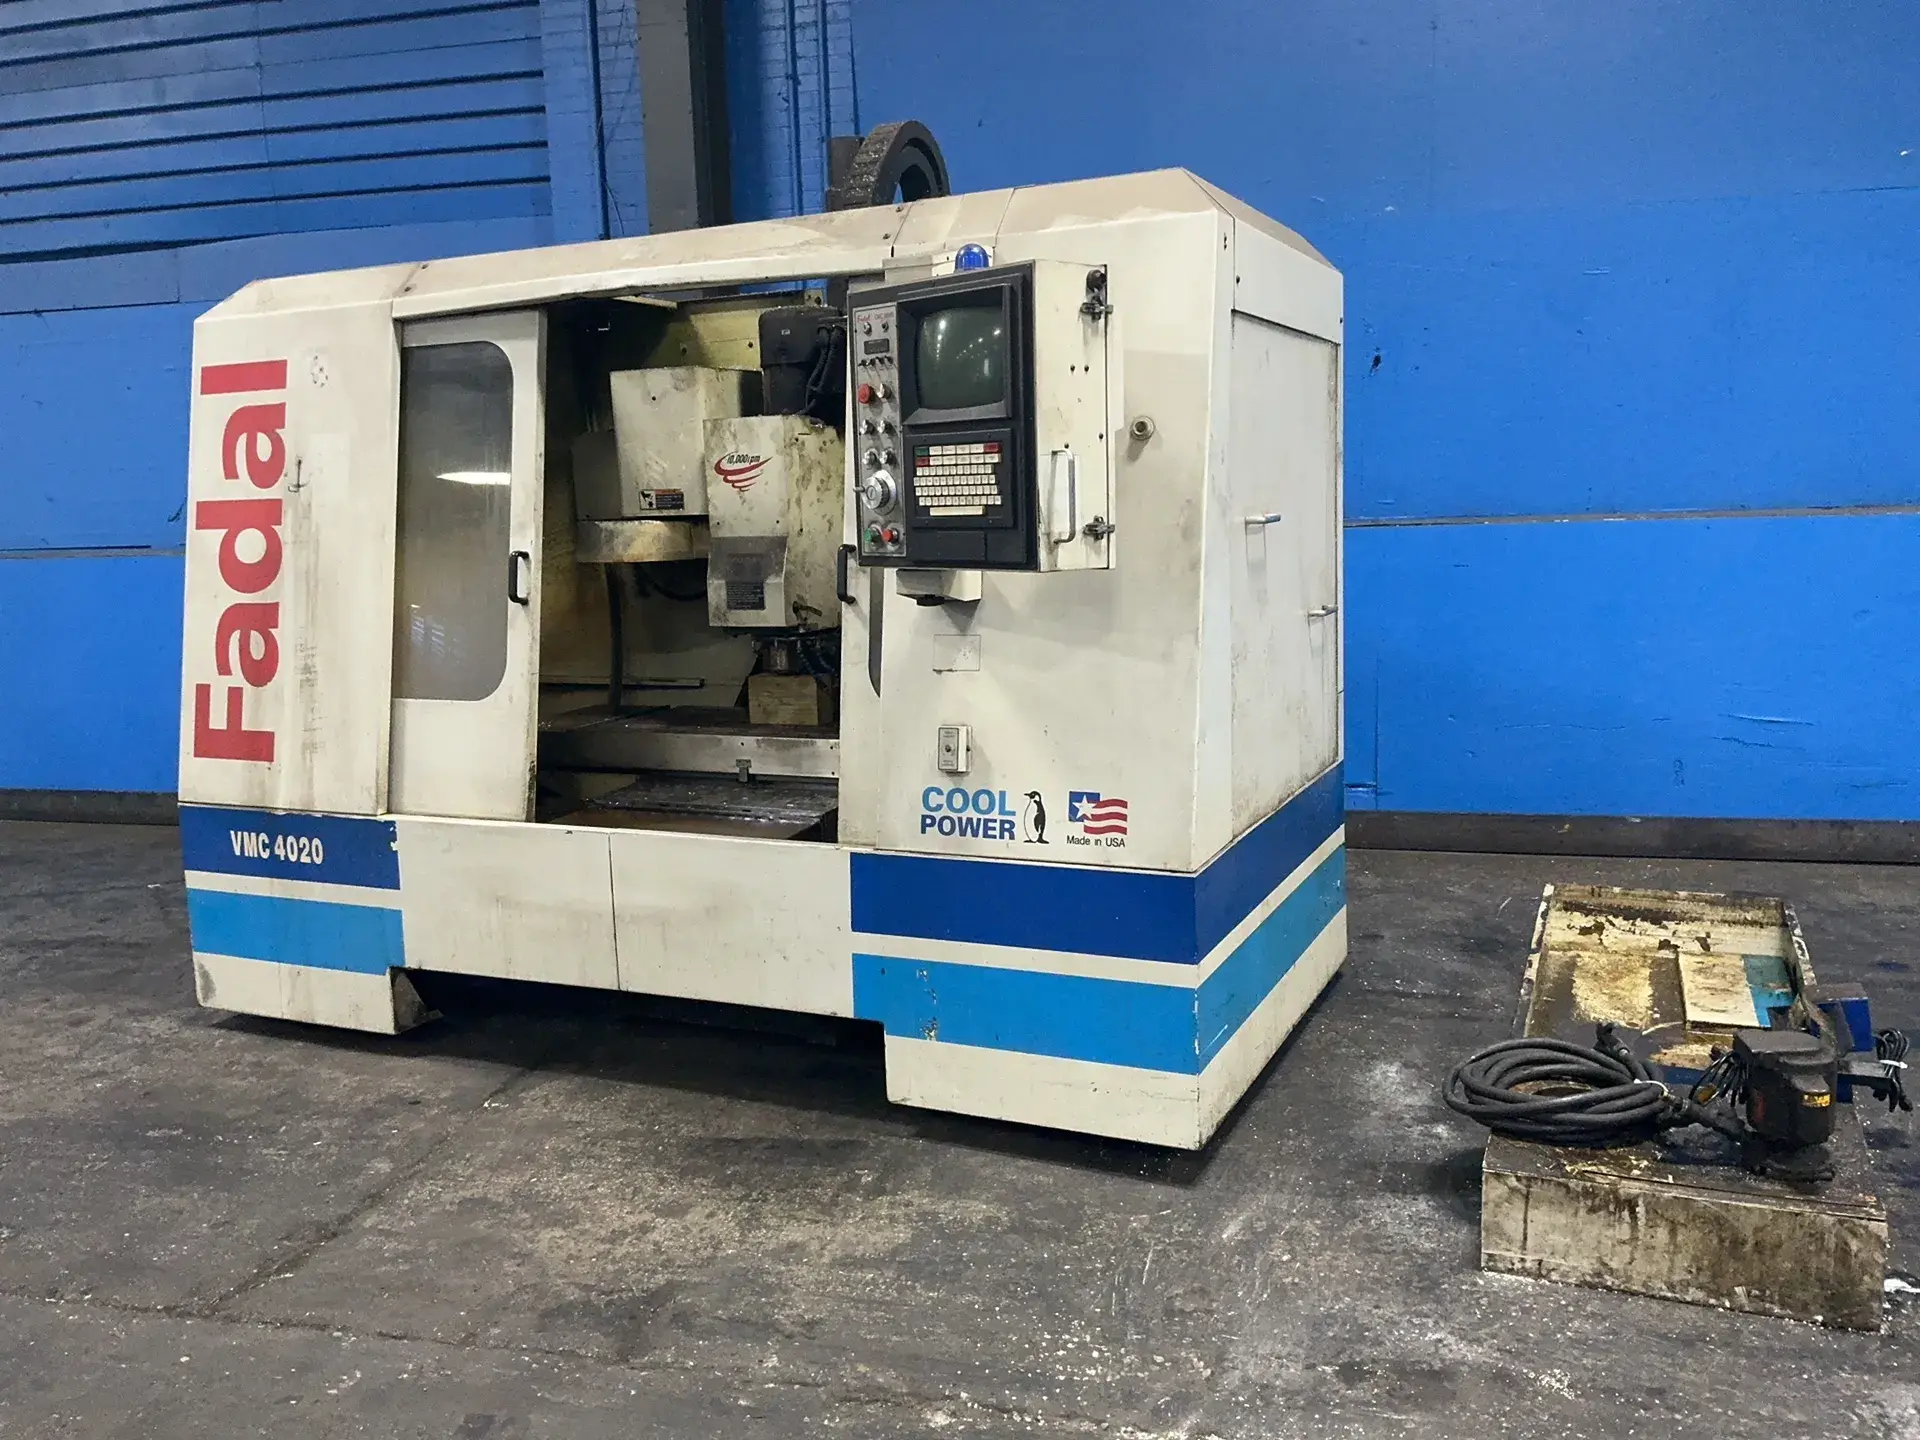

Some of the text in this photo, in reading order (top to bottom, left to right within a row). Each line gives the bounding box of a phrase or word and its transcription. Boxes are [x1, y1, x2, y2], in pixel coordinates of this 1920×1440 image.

[194, 360, 288, 762] Fadal
[922, 786, 1016, 816] COOL
[920, 814, 1016, 840] POWER
[1066, 834, 1126, 848] Made in USA
[229, 830, 324, 865] VMC 4020
